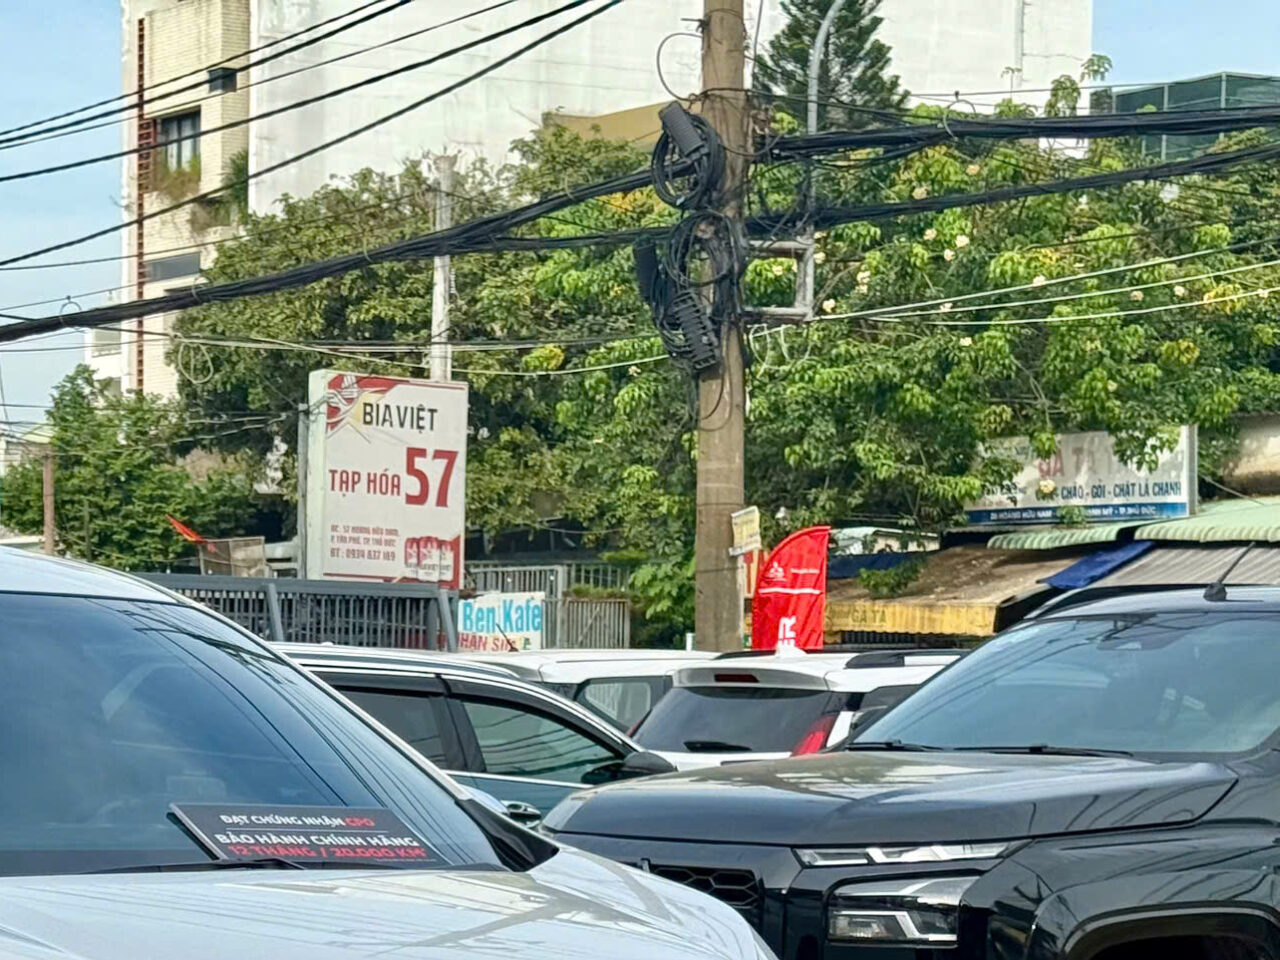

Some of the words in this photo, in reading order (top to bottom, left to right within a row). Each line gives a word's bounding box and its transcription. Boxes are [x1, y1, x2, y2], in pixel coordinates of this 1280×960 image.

[362, 402, 393, 428] BIA
[395, 403, 438, 434] VIỆT
[328, 469, 361, 498] TẠP
[367, 468, 401, 497] HÓA
[405, 446, 459, 508] 57
[1152, 481, 1182, 497] CHANH
[463, 601, 496, 634] Ben
[220, 814, 250, 826] ĐẠT
[251, 813, 303, 826] CHỨNG
[304, 816, 345, 828] NHẬN
[214, 831, 253, 844] BẢO
[254, 833, 310, 845] HÀNH
[311, 834, 364, 846] CHÍNH
[366, 835, 420, 847] HÃNG
[228, 845, 251, 855] 12
[252, 844, 318, 857] THÁNG
